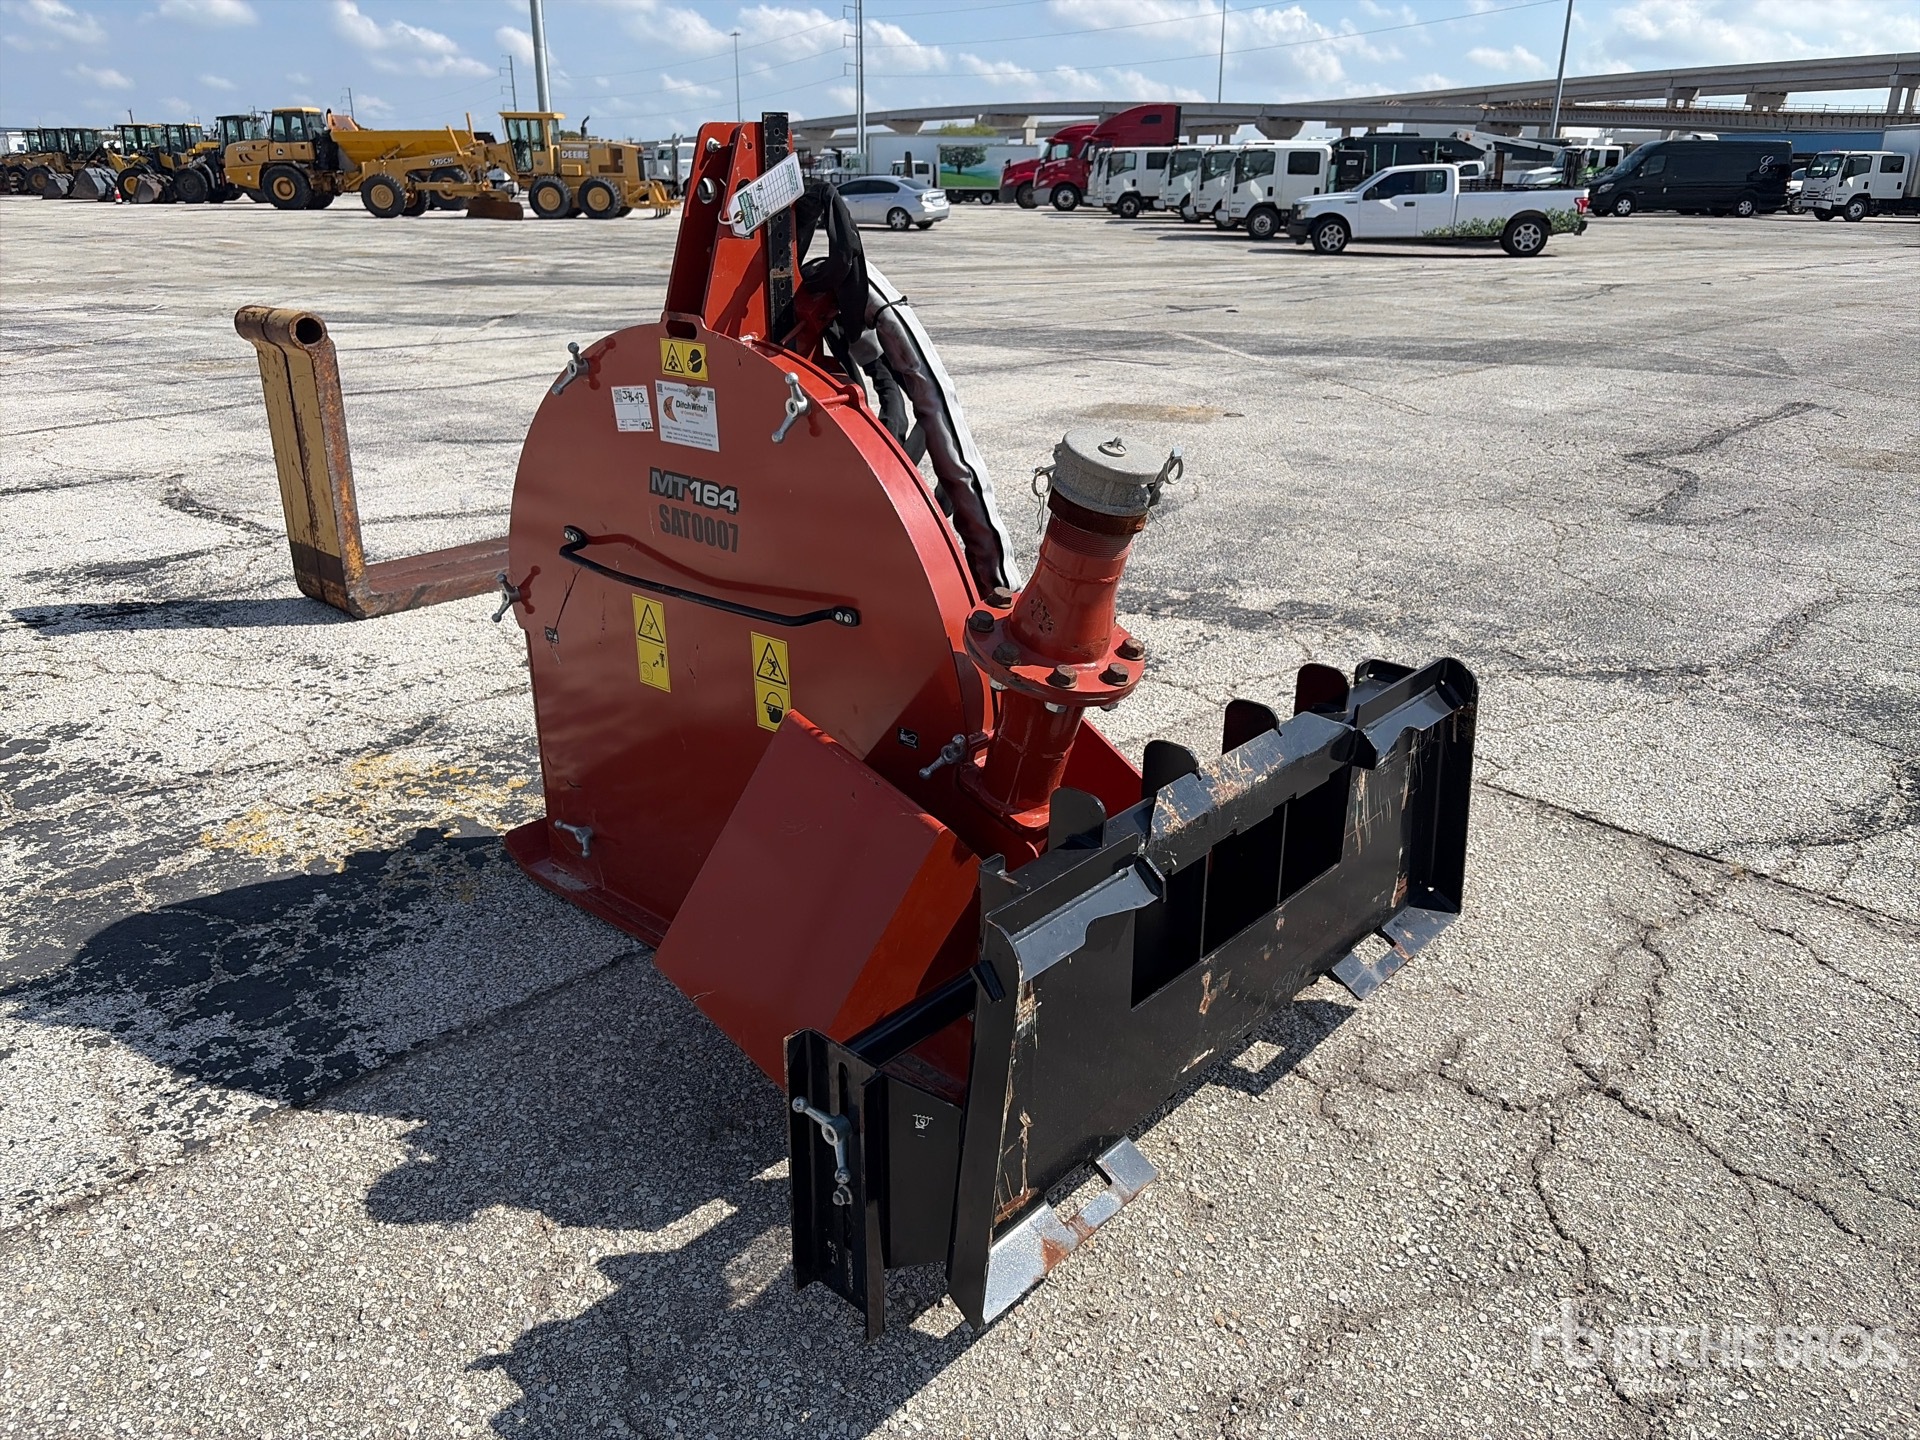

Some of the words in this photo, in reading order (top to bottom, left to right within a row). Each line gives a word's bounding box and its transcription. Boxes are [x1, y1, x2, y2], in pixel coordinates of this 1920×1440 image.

[187, 154, 207, 169] CASE
[561, 150, 589, 159] DEERE
[649, 467, 739, 515] MT164
[659, 503, 739, 553] SAT0007
